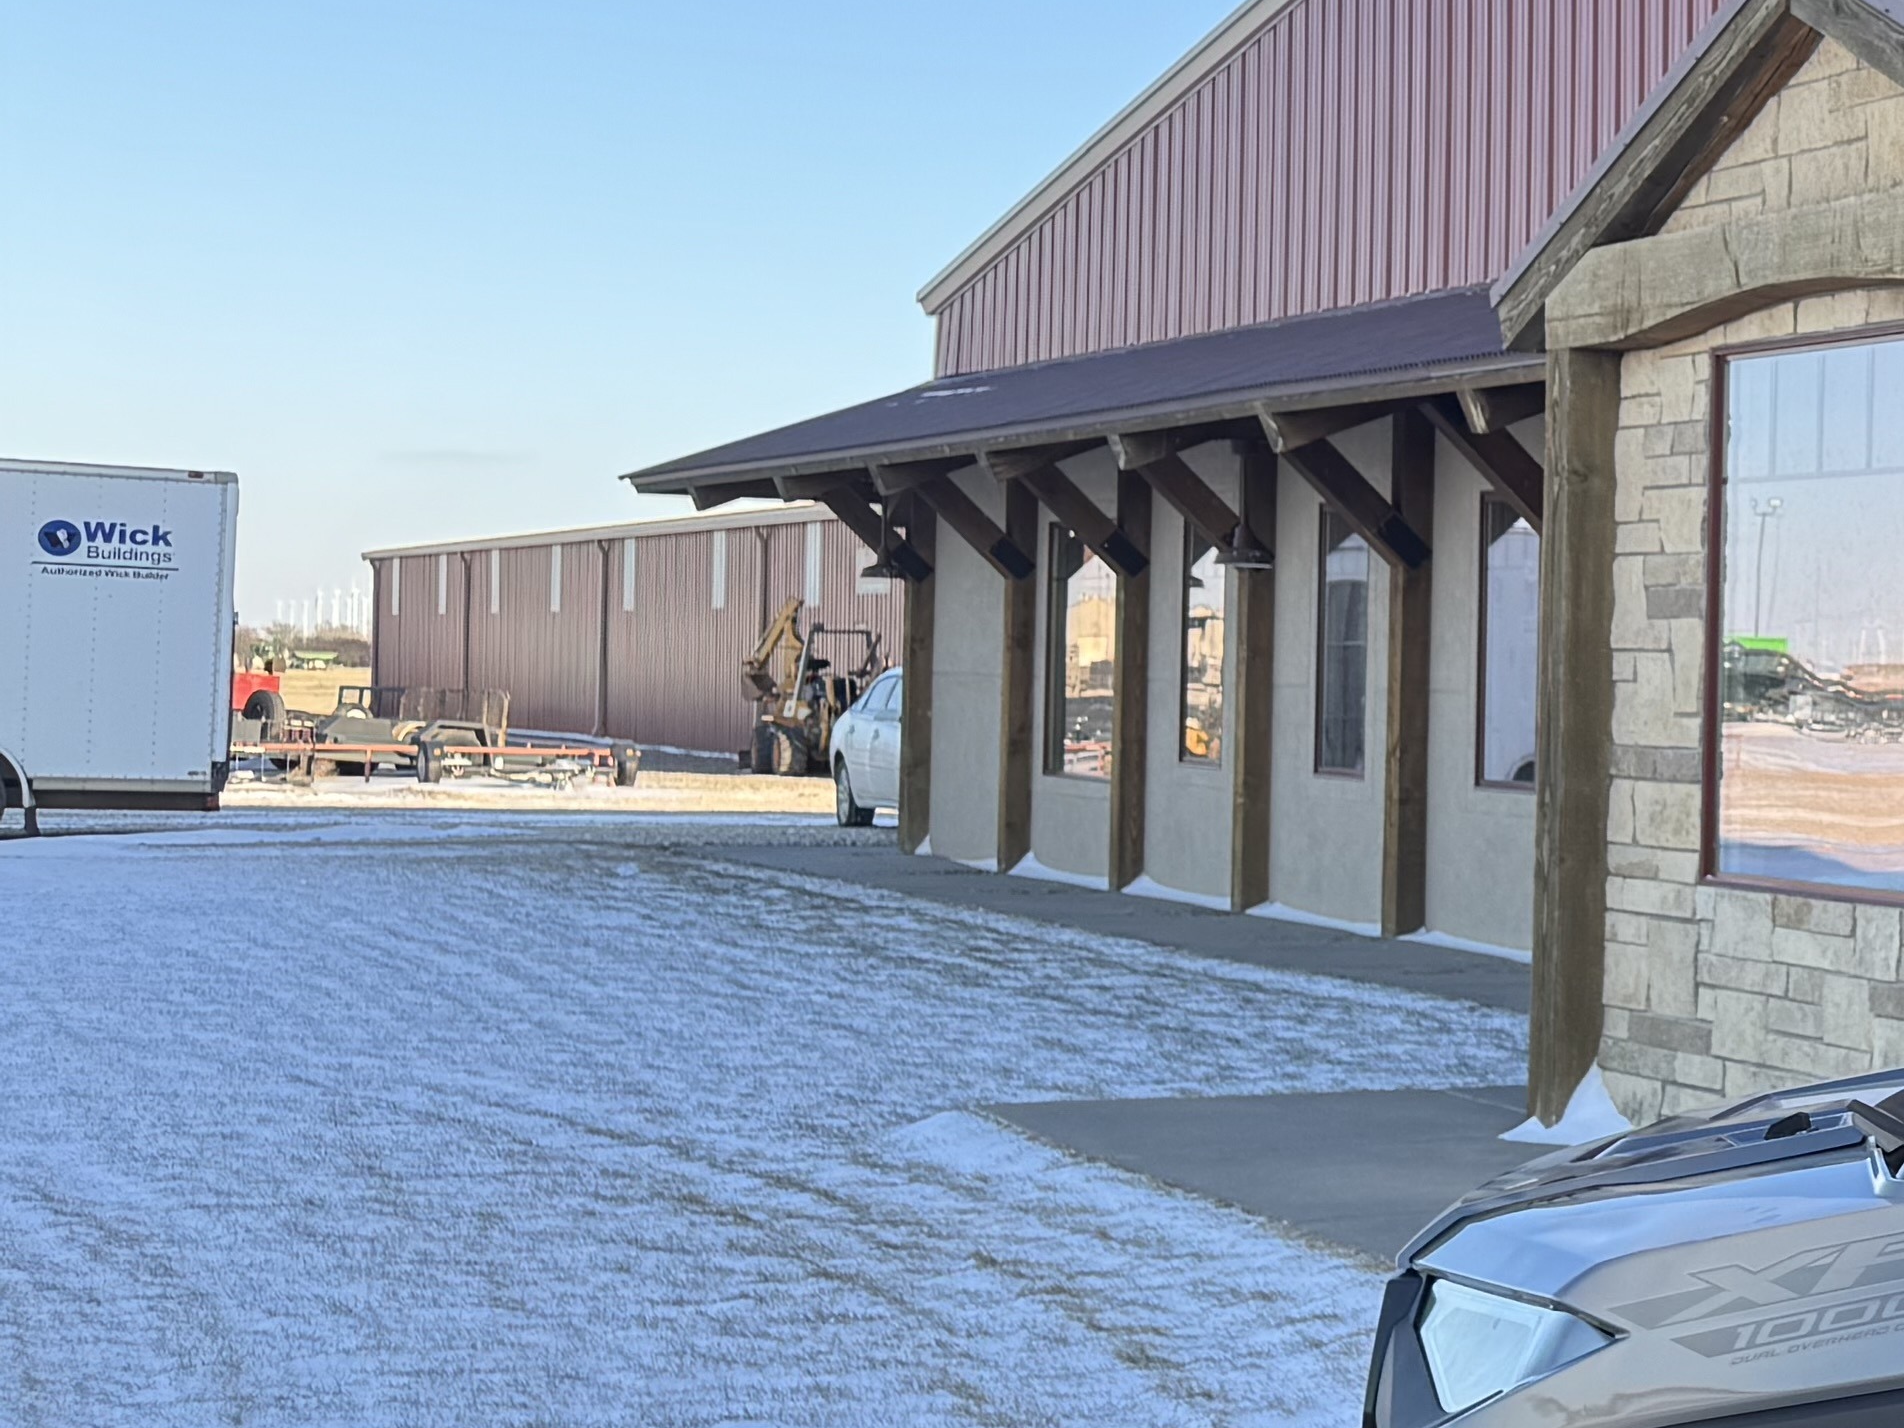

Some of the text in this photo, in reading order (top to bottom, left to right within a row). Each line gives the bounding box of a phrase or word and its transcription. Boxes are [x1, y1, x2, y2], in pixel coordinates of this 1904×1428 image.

[83, 521, 172, 547] Wick
[87, 545, 172, 565] Buildings
[41, 566, 101, 578] Authorized
[1729, 1348, 1781, 1365] DUAL
[1786, 1325, 1890, 1352] OVERHEAD
